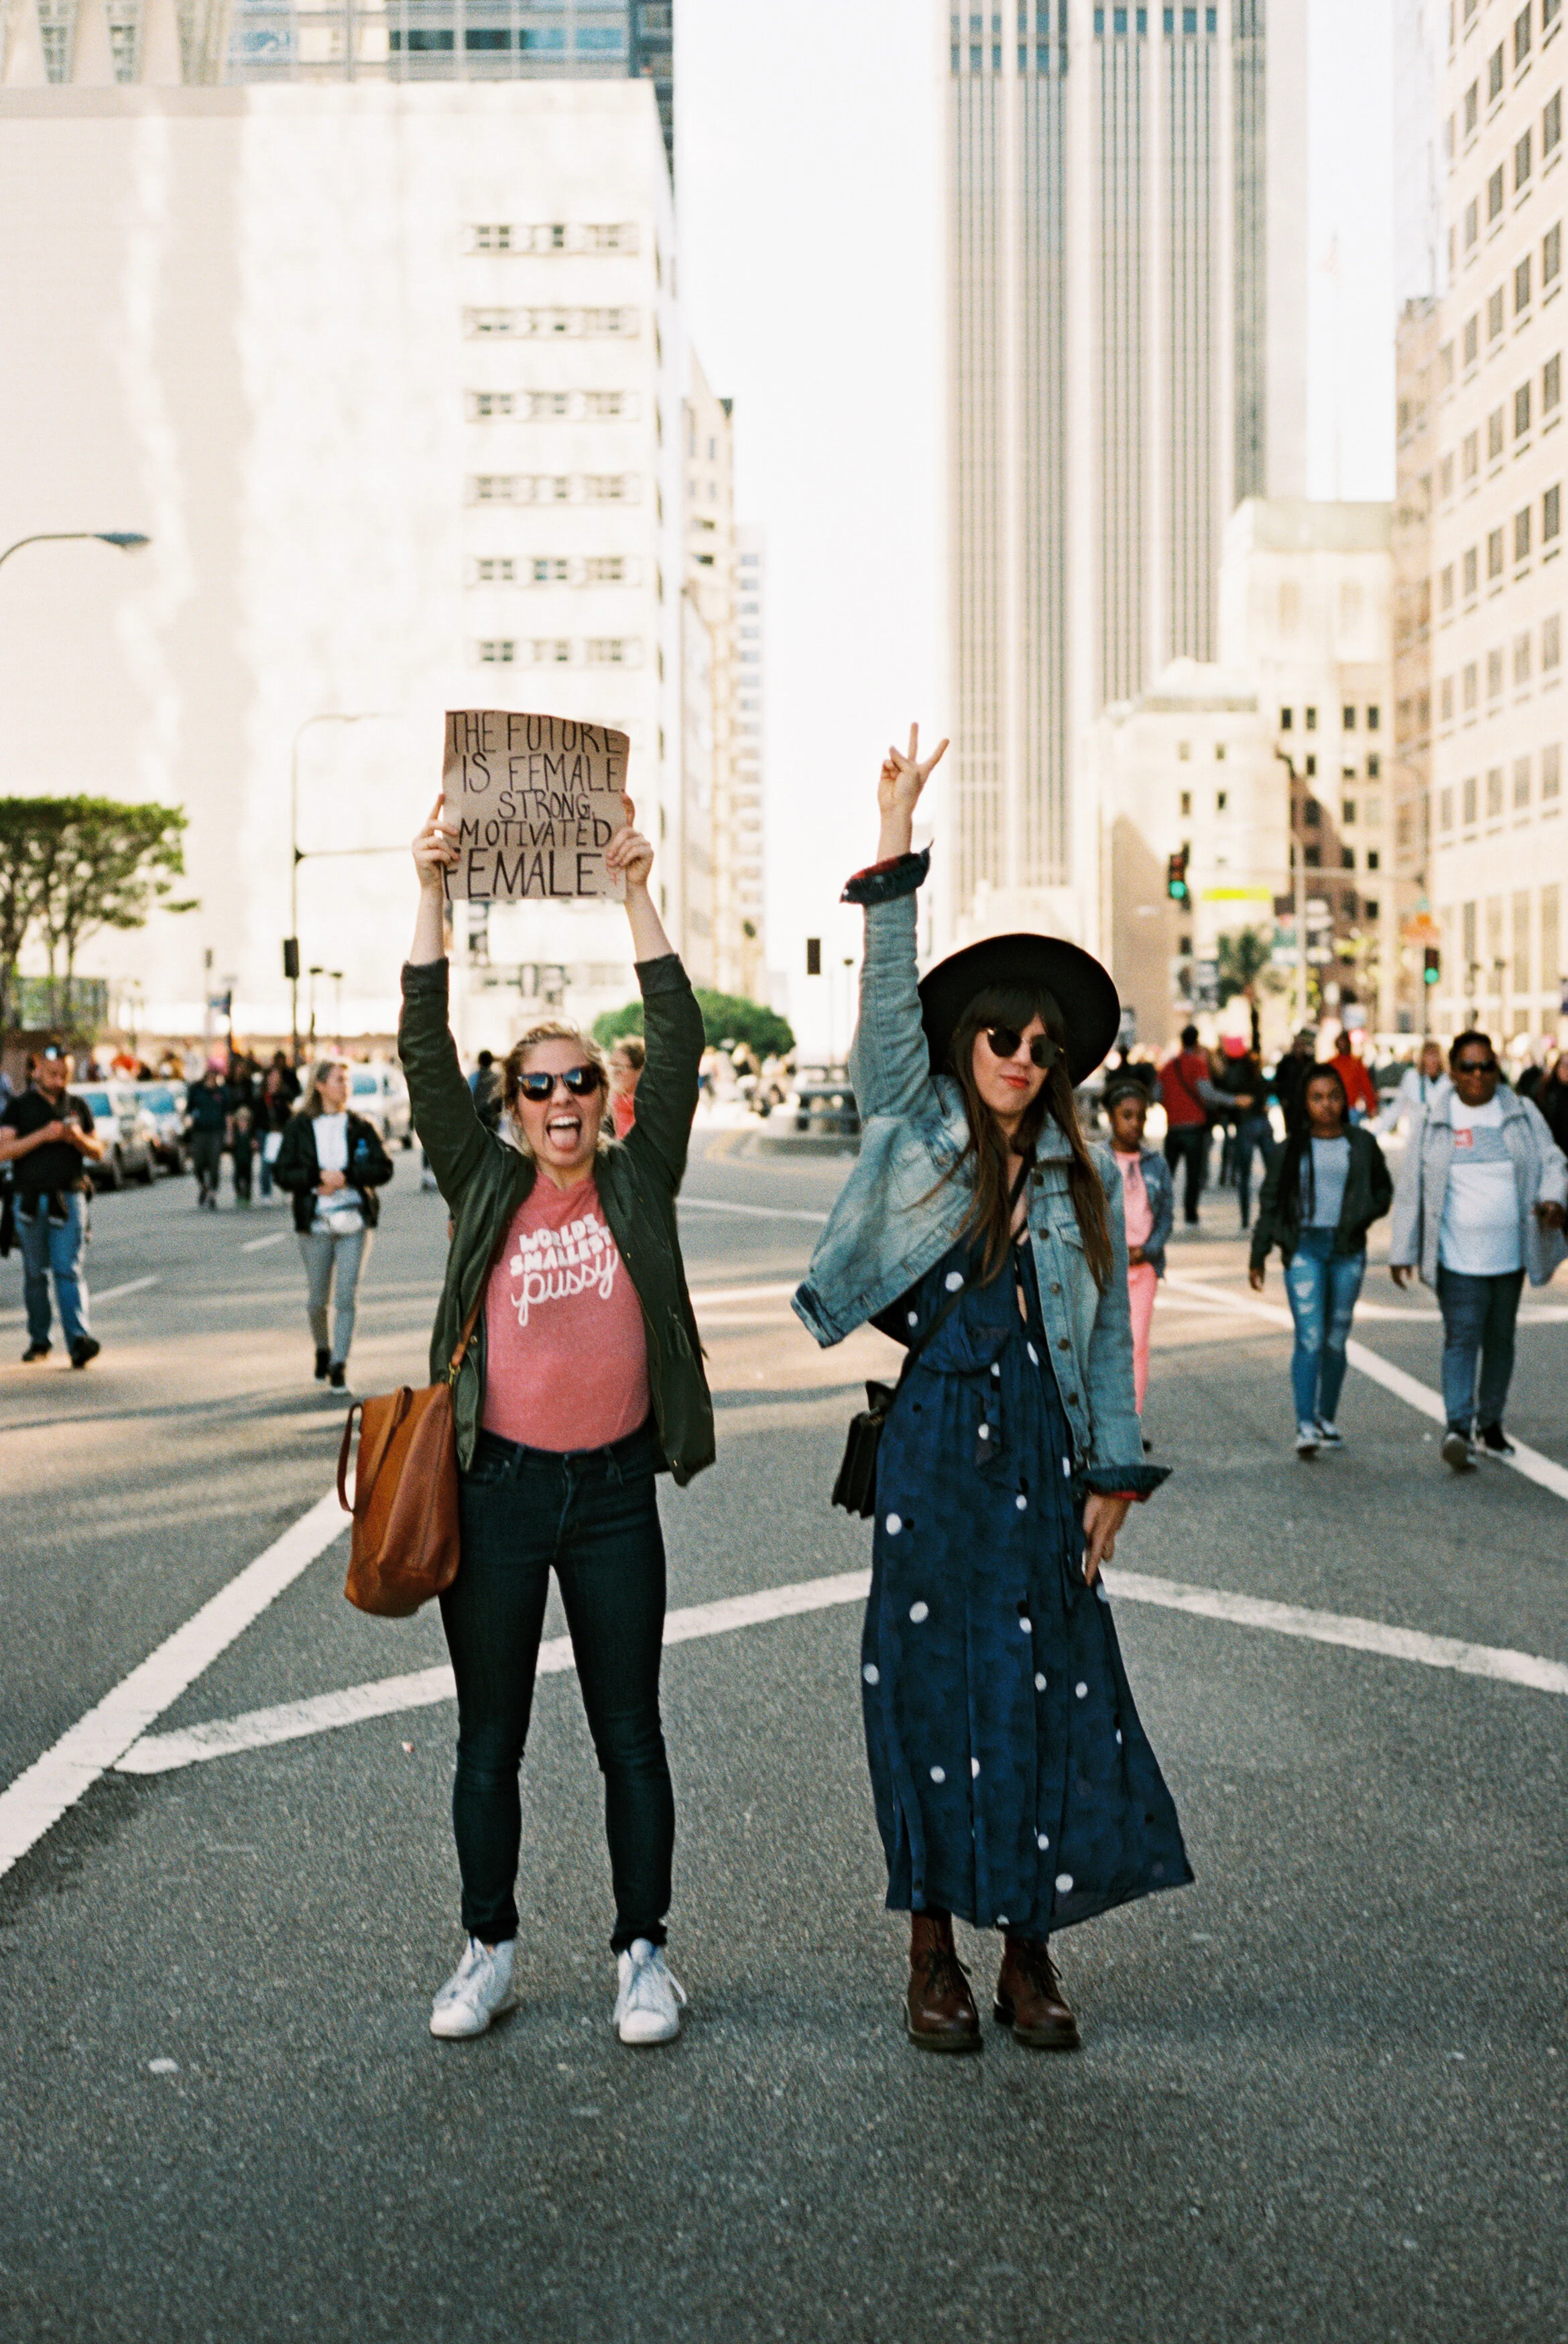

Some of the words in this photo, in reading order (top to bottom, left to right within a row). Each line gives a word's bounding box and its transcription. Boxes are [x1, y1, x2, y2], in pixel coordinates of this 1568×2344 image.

[446, 711, 497, 754] THE
[507, 713, 623, 754] FUTURE
[463, 752, 491, 793] IS
[459, 817, 613, 847] MOTIVATED
[509, 1225, 611, 1277] SMALLEST
[511, 1248, 619, 1326] pussy
